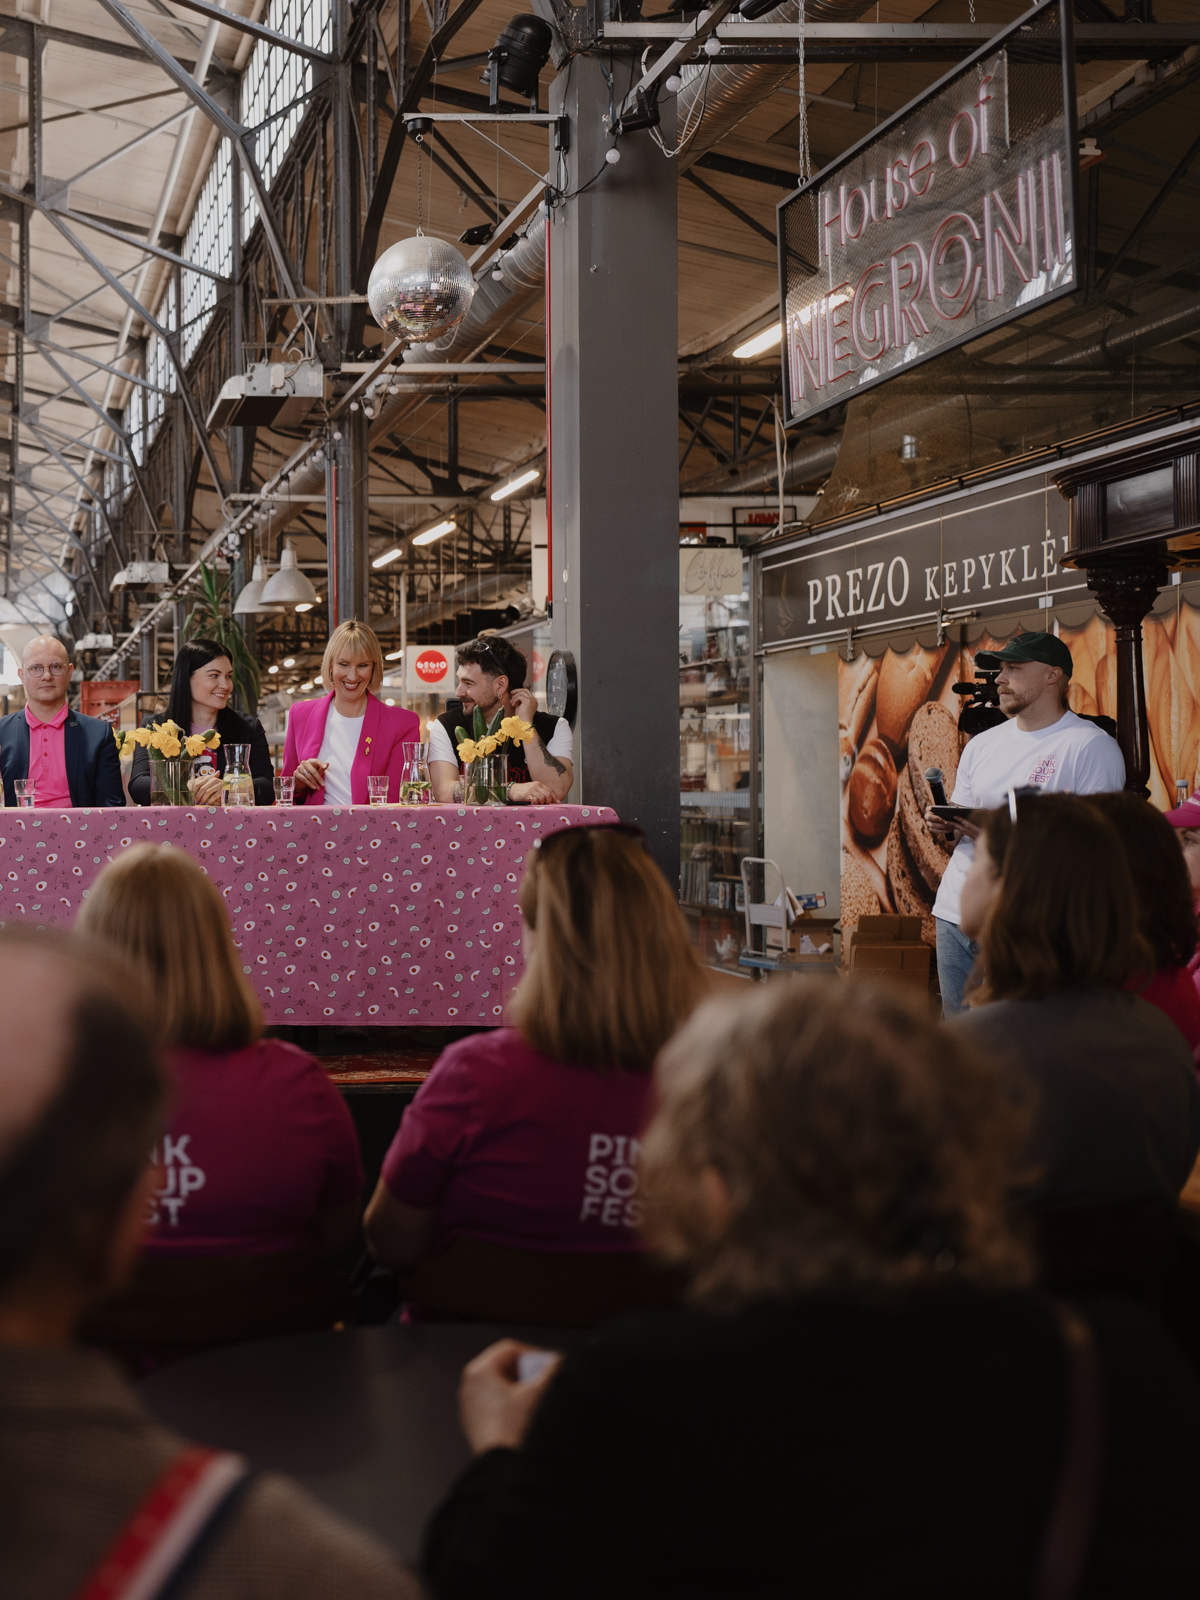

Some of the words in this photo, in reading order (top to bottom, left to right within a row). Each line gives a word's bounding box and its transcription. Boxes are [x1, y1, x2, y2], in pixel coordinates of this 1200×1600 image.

[823, 140, 936, 256] House
[949, 75, 994, 169] of
[743, 512, 785, 524] JAW
[683, 550, 739, 594] Coffee
[807, 555, 910, 625] PREZO
[416, 660, 447, 669] GEGIO
[1029, 774, 1050, 782] FEST
[584, 1164, 640, 1197] SO
[579, 1196, 644, 1228] FES
